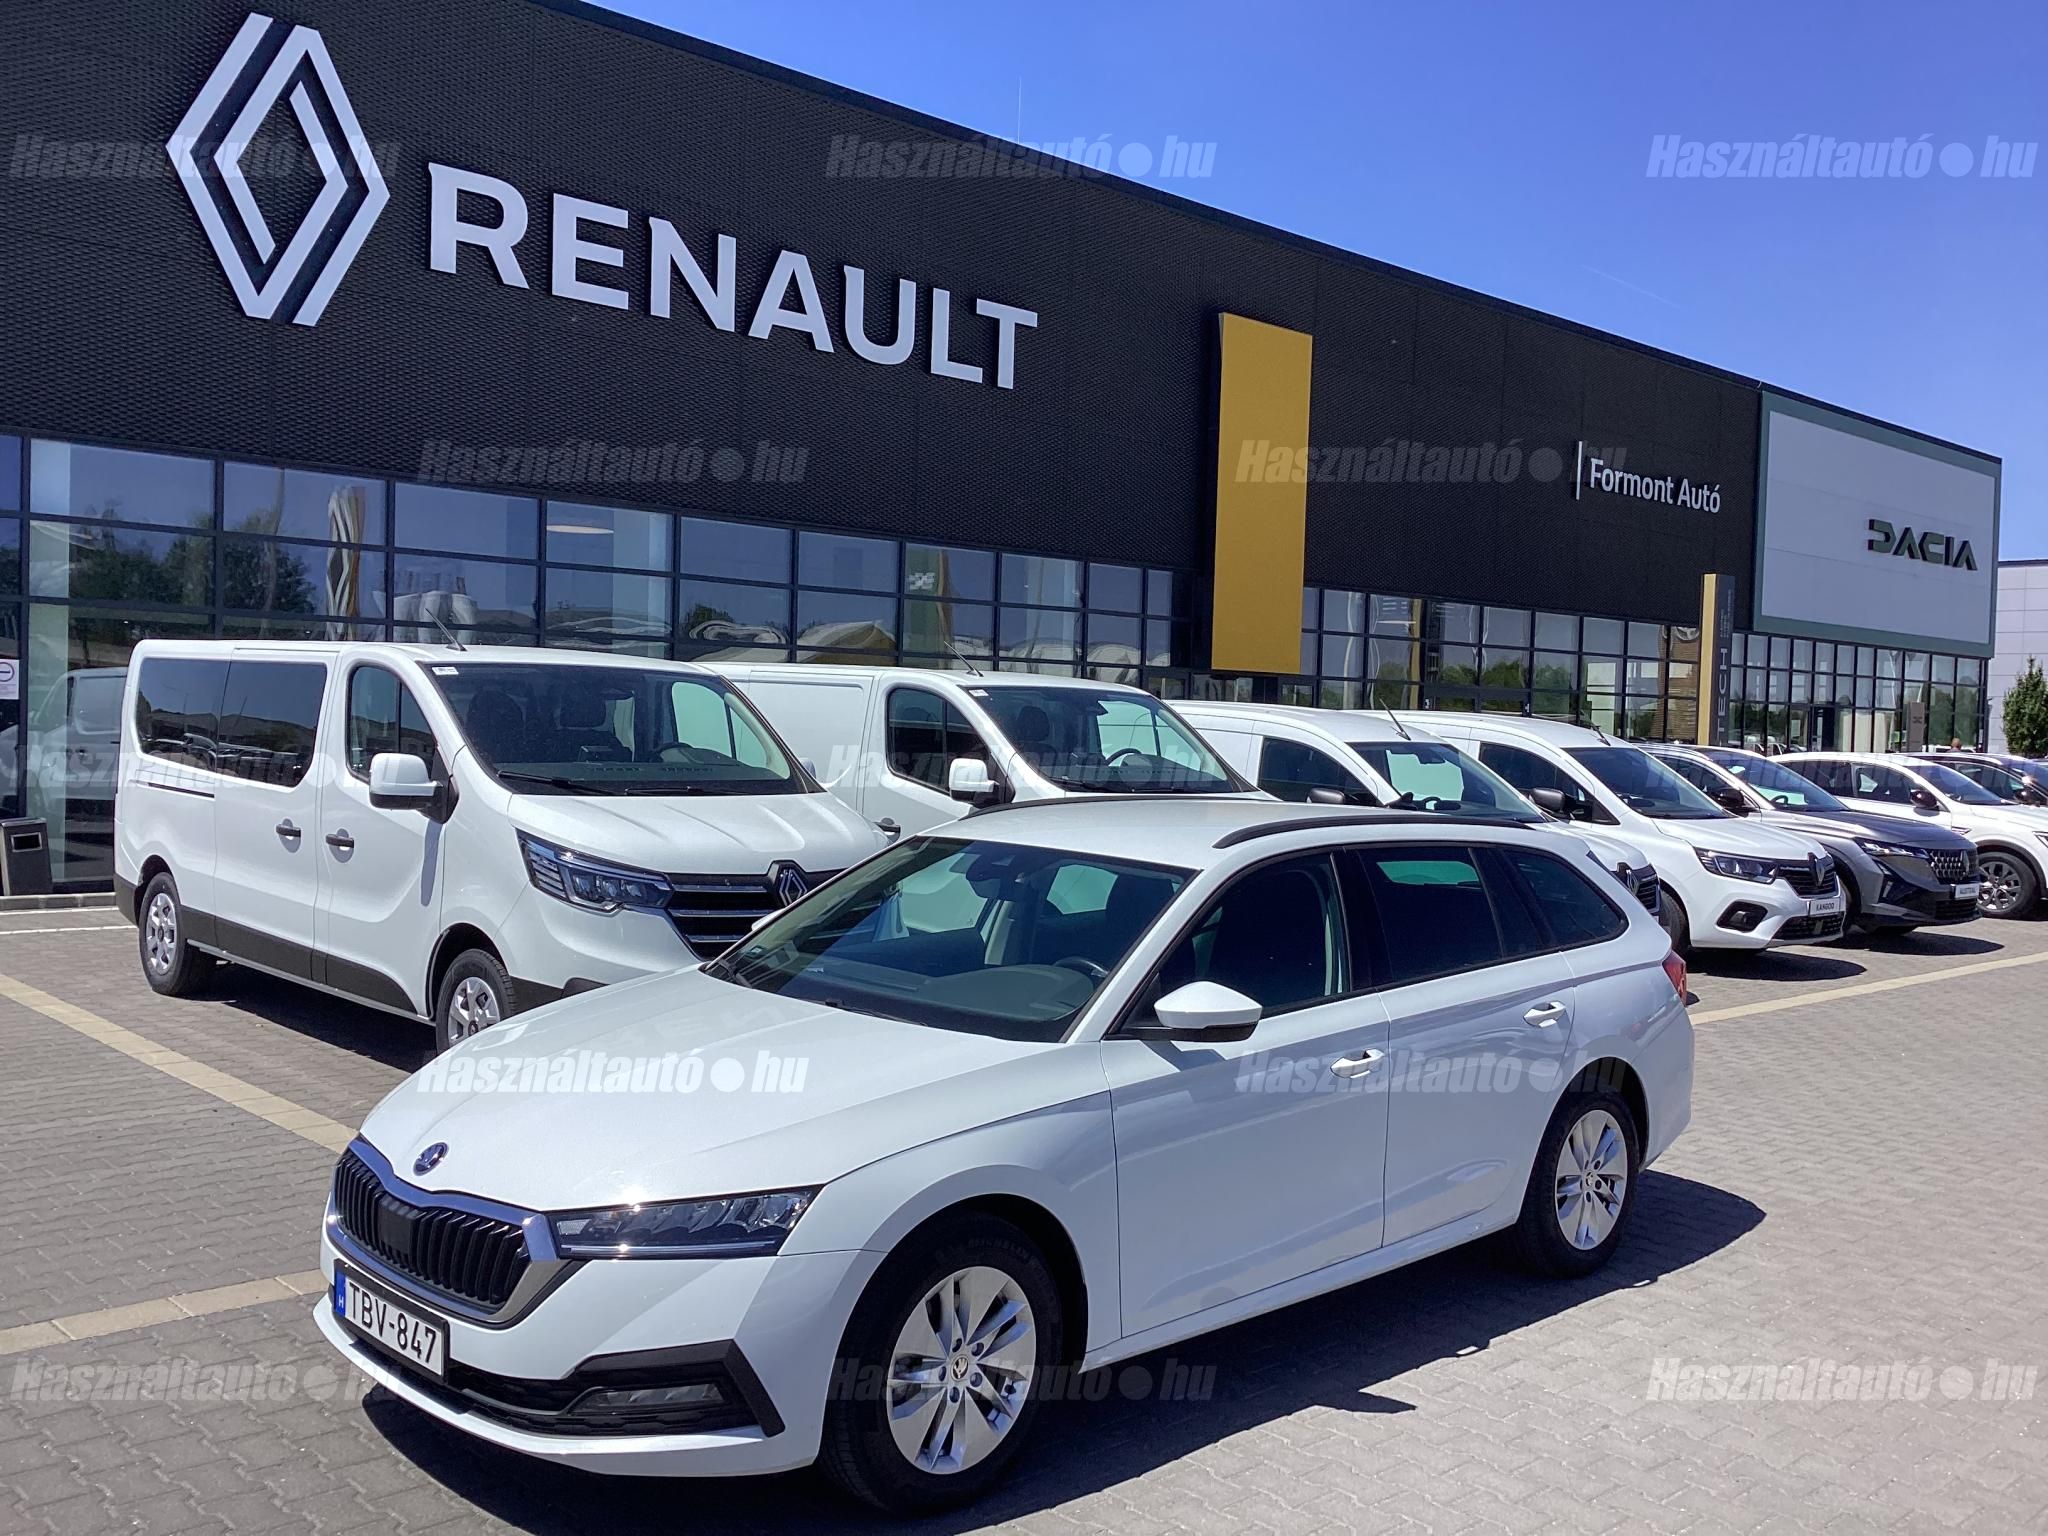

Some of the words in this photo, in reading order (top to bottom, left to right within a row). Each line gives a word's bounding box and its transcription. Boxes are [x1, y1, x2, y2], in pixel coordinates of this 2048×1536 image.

[428, 162, 1038, 389] RENAULT
[1590, 458, 1674, 504] Formont
[1677, 484, 1721, 514] Autó
[1868, 519, 1978, 571] DACIA
[338, 1294, 344, 1309] H
[349, 1281, 437, 1363] TBV-847
